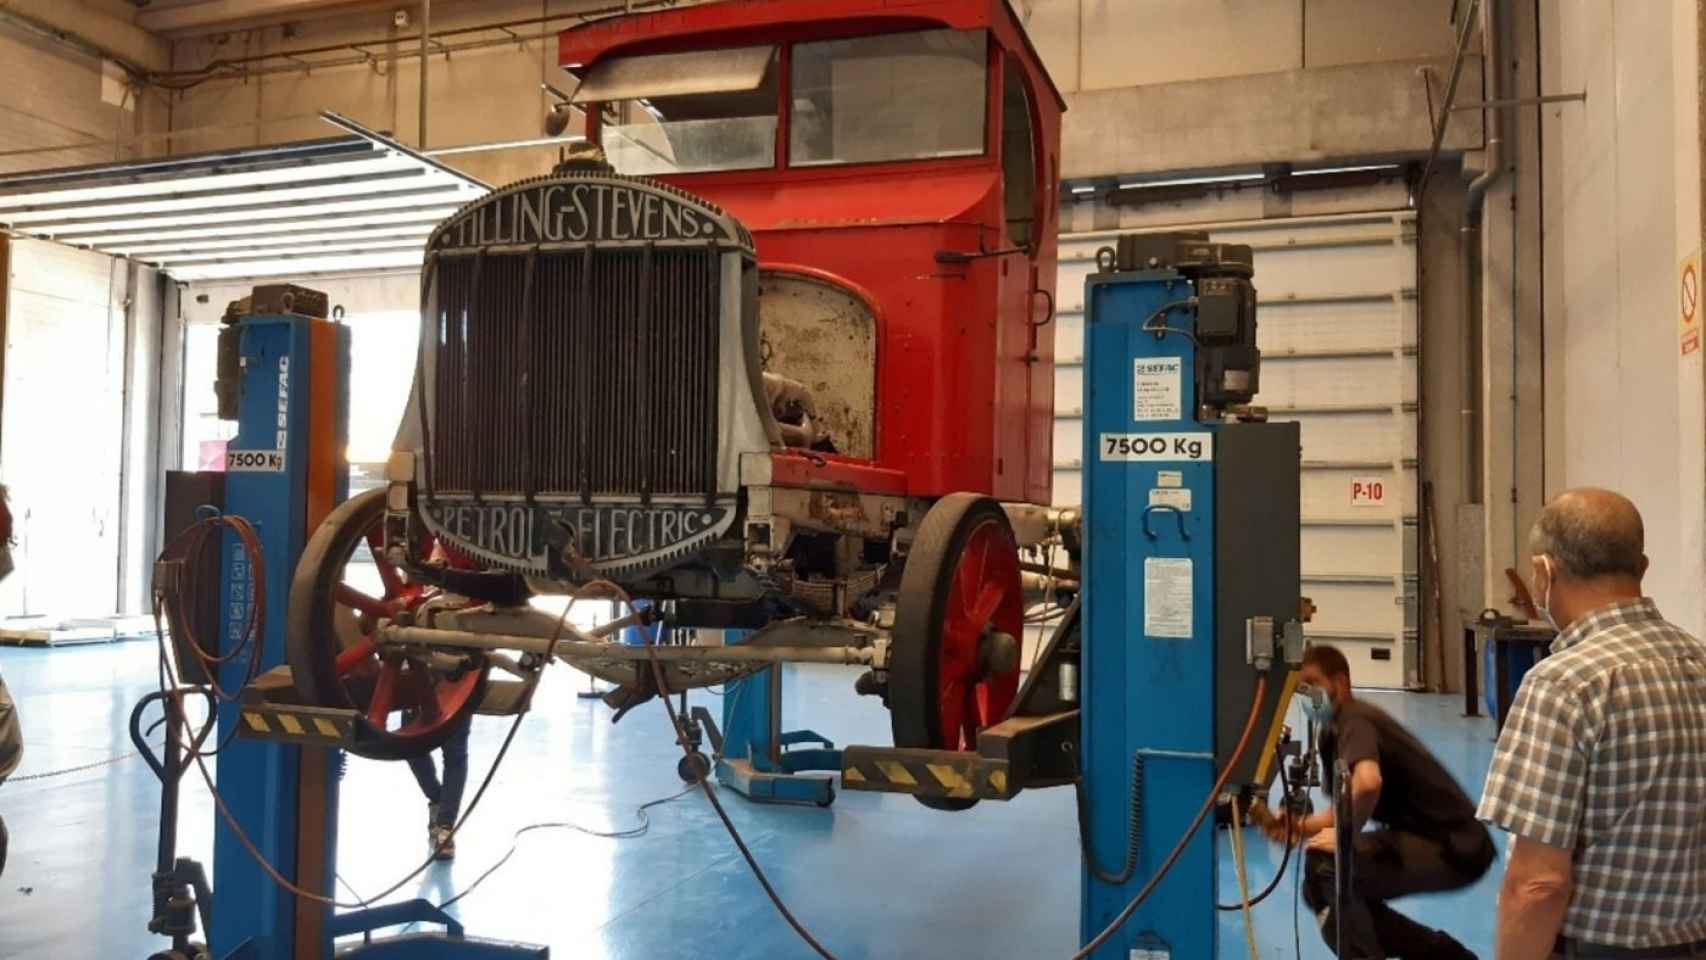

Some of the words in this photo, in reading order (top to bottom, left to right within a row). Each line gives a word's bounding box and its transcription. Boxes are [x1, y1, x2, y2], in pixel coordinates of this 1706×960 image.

[456, 184, 699, 247] TILLING-STEVENS
[1105, 438, 1167, 454] 7500
[1174, 439, 1203, 459] Kg
[229, 453, 265, 467] 7500
[269, 454, 282, 470] Kg
[1353, 482, 1383, 500] P-10
[444, 505, 546, 562] PETROL
[577, 507, 700, 562] ELECTRIC
